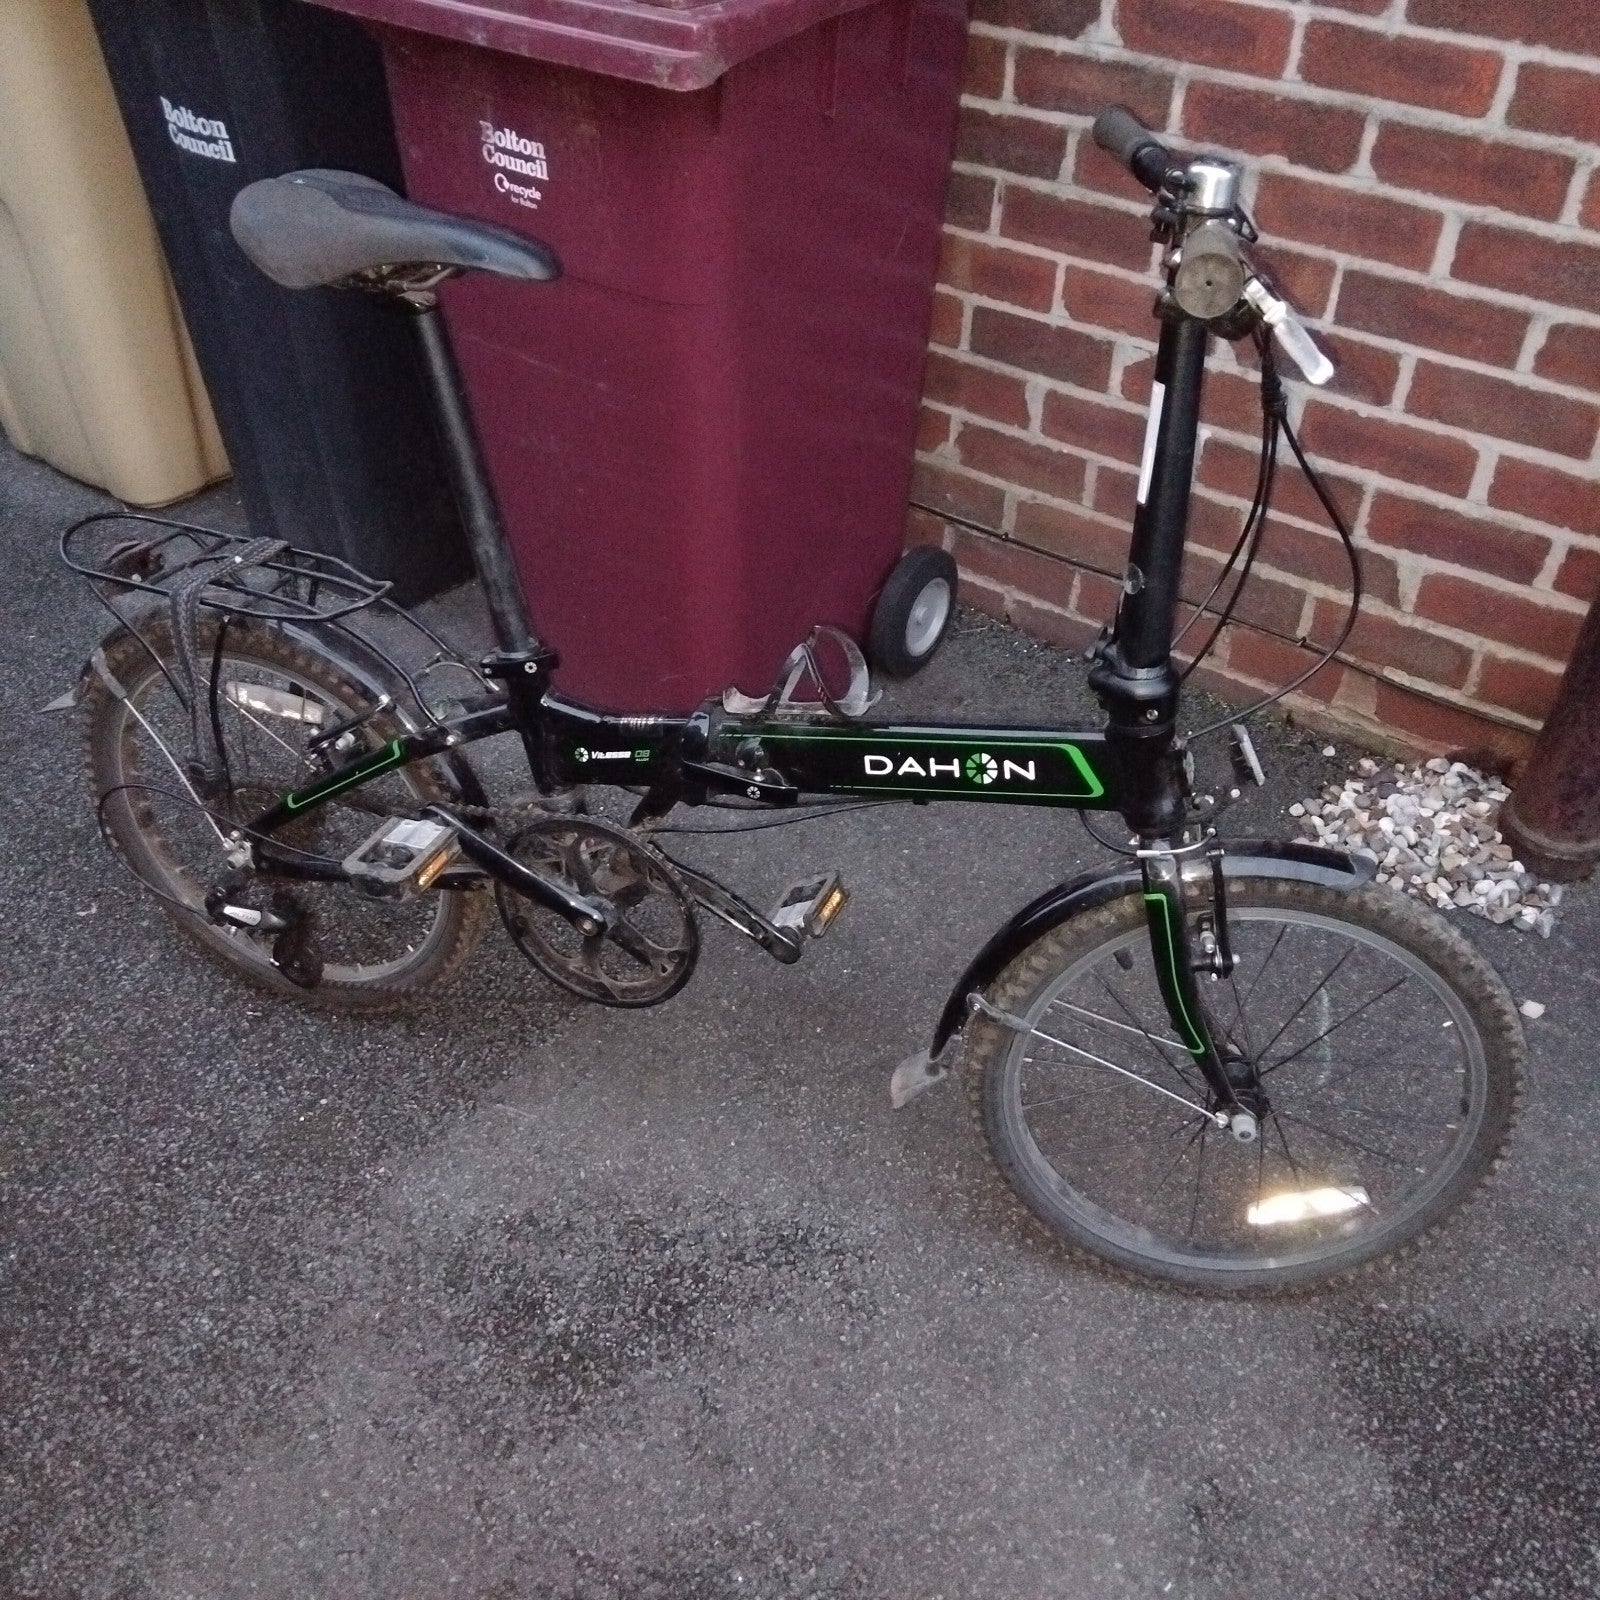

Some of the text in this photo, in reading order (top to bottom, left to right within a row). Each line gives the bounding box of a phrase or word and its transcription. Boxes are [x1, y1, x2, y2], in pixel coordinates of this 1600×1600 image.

[160, 96, 229, 139] Bolton
[168, 122, 237, 163] Council
[479, 120, 547, 160] Bolton
[482, 143, 549, 181] Council
[509, 183, 541, 200] recycle
[864, 752, 1036, 785] DAHON
